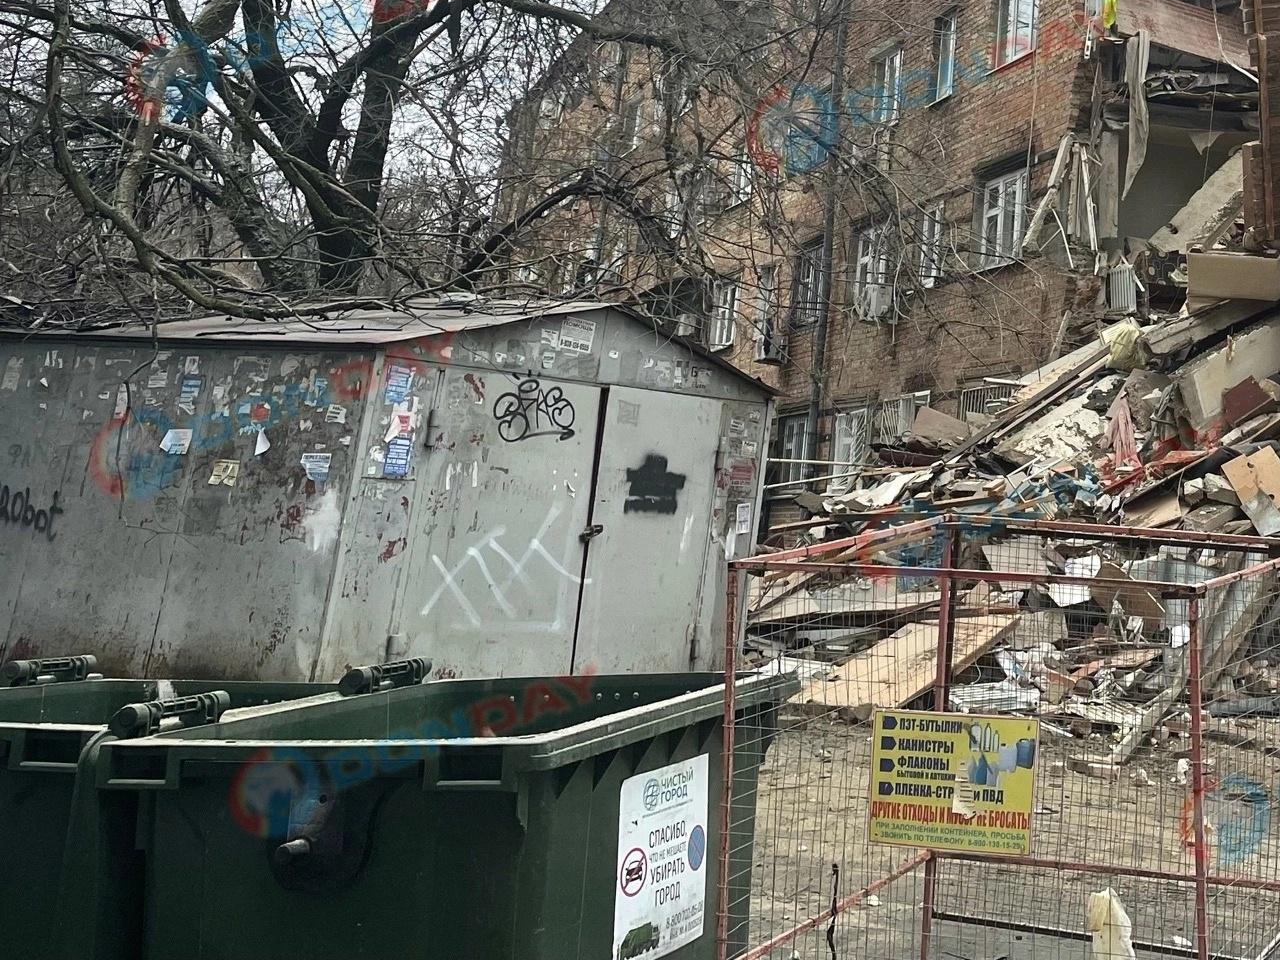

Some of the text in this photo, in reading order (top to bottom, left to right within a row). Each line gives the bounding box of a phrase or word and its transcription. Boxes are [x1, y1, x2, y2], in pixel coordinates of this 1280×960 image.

[899, 718, 962, 734] ПЭТ-БУТЫЛКИ
[898, 738, 954, 754] КАНИСТРЫ
[897, 755, 949, 771] ФЛАКОНЫ
[661, 766, 694, 789] ЧИСТЫЙ
[660, 785, 688, 805] ГОРОД
[982, 789, 1004, 805] ПВД
[872, 800, 901, 819] ДРУГИЕ
[903, 802, 938, 824] ОТХОДЫ
[939, 805, 945, 824] И
[988, 810, 1031, 830] БРОСАТЬ!
[649, 820, 687, 849] СПАСИБО,
[875, 821, 890, 829] ПРИ
[890, 822, 939, 834] ЗАПОЛНЕНИИ
[990, 832, 1026, 841] ПРОСЬБА
[880, 832, 912, 840] ЗВОНИТЬ
[913, 834, 923, 842] ПО
[650, 857, 685, 886] УБИРАТЬ
[654, 881, 681, 908] ГОРОД
